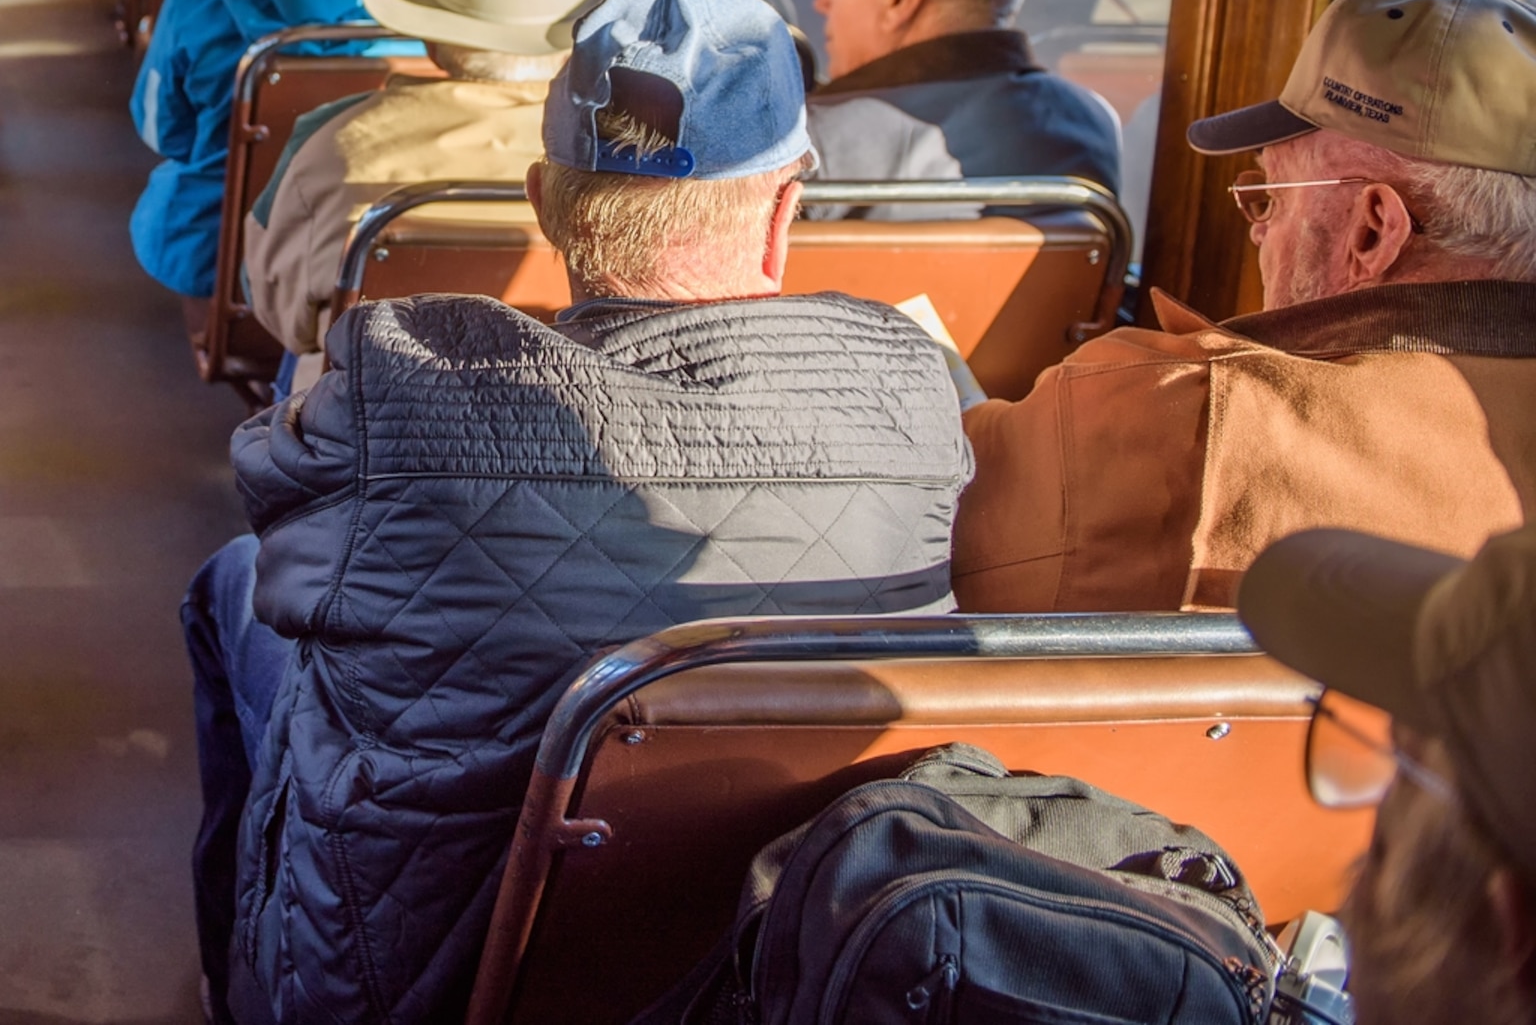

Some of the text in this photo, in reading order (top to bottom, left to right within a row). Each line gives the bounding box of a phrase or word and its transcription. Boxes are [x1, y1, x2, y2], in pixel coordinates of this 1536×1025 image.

[1323, 76, 1403, 116] COUNTRY OPERATIONS
[1364, 105, 1390, 124] TEXAS
